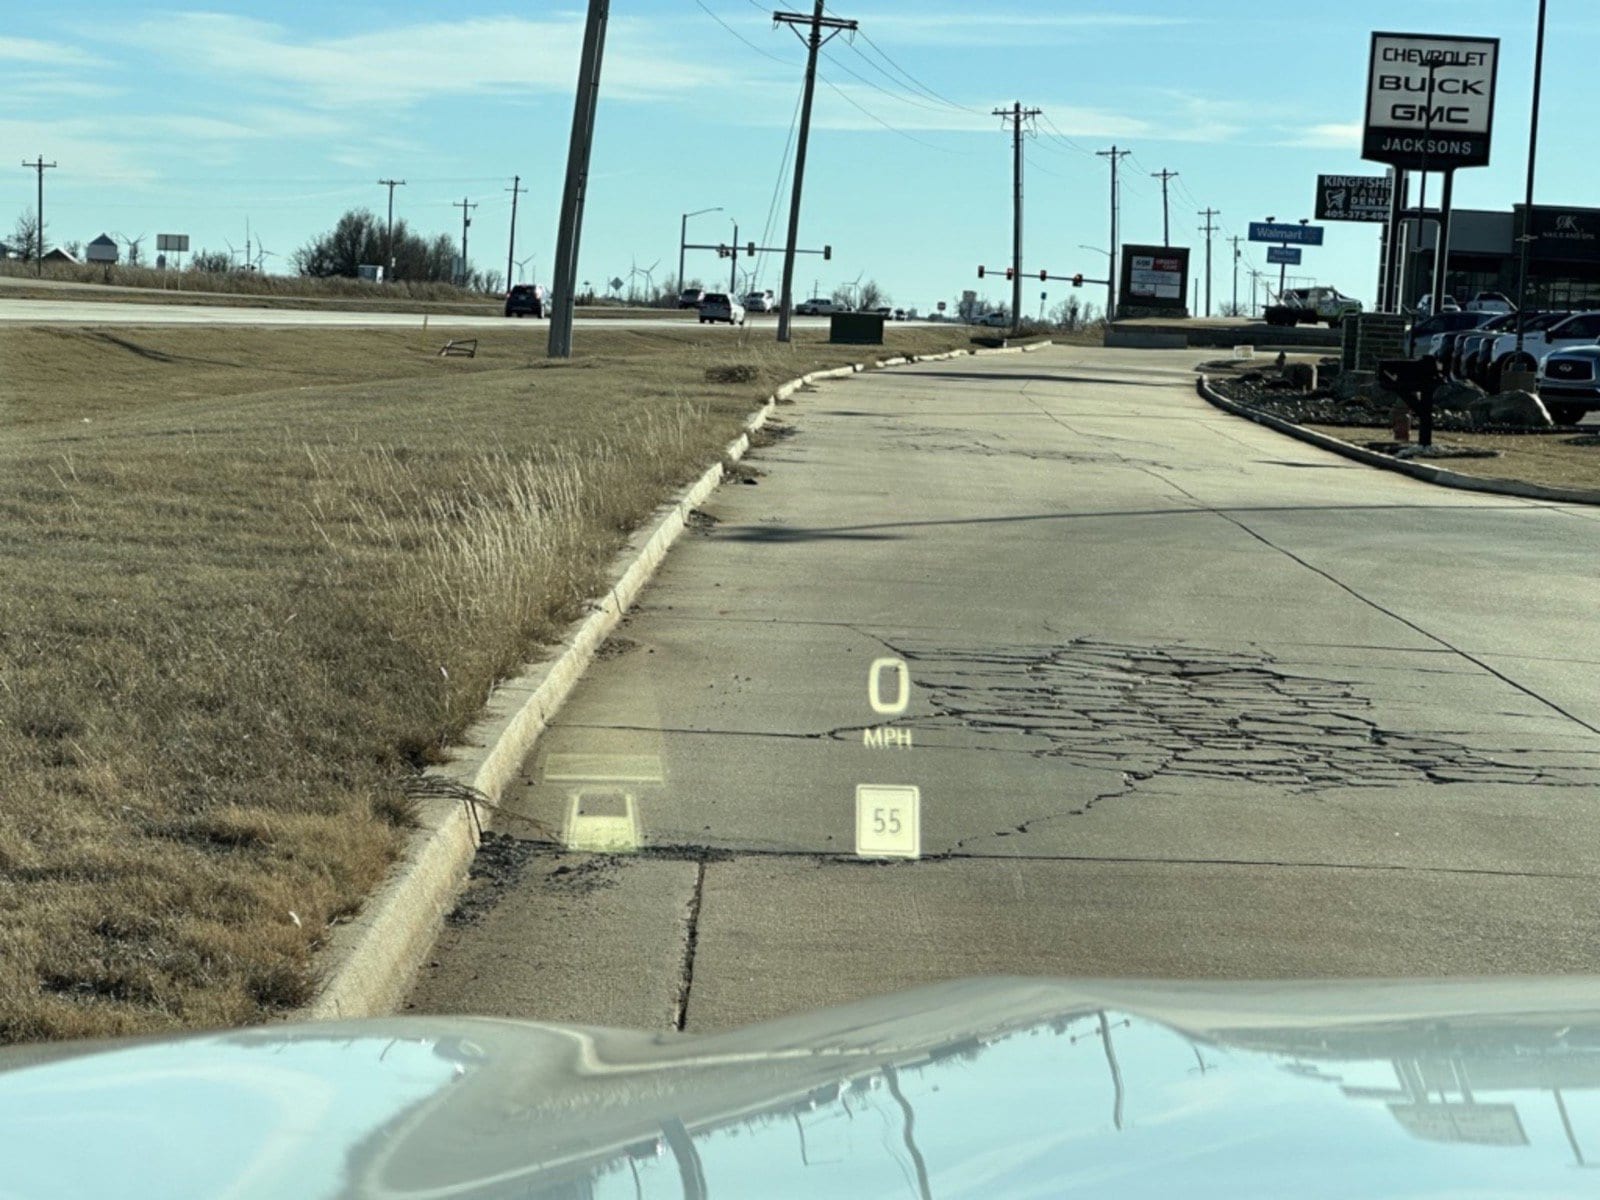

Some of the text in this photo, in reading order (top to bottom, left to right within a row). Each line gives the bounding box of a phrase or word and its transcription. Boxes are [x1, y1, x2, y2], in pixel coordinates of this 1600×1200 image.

[1383, 47, 1487, 66] CHEVROLET
[1379, 75, 1484, 96] BUICK
[1391, 104, 1469, 124] GMC
[1382, 138, 1472, 155] JACKSONS
[1324, 175, 1392, 189] KINGFISHE
[1256, 227, 1303, 240] Walmart
[864, 728, 912, 748] MPH
[873, 808, 901, 834] 55
